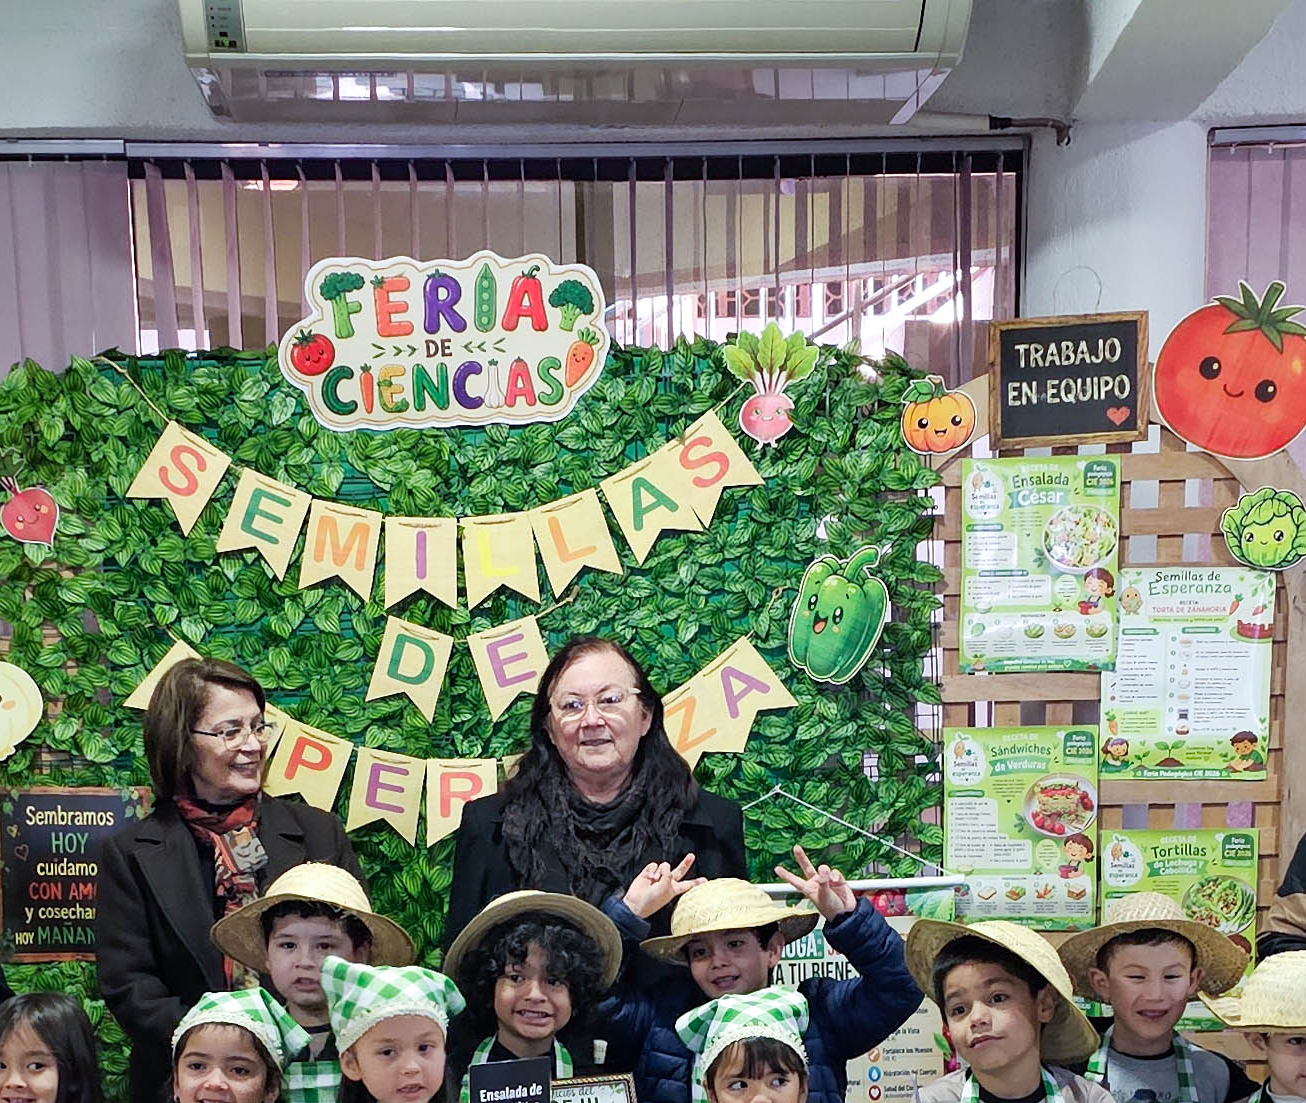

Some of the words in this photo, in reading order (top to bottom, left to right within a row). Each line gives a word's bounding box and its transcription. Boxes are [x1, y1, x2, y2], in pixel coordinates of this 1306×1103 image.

[319, 263, 549, 339] FERIA
[424, 338, 454, 358] DE
[1013, 336, 1122, 369] TRABAJO
[321, 356, 562, 414] CIENCIAS
[1007, 381, 1039, 407] EN
[1045, 373, 1131, 404] EQUIPO
[1012, 472, 1070, 489] Ensalada
[1017, 488, 1064, 506] César
[157, 435, 731, 580] SEMILLAS
[1155, 571, 1204, 583] Semillas
[1207, 571, 1221, 581] de
[1148, 581, 1232, 597] Esperanza
[389, 632, 537, 689] DE
[991, 743, 1052, 758] Sándwiches
[1006, 759, 1047, 771] Verduras
[25, 804, 114, 826] Sembramos
[51, 831, 89, 854] HOY
[1150, 843, 1207, 859] Tortillas
[36, 858, 98, 876] cuidamo
[29, 882, 62, 900] CON
[69, 882, 98, 900] AM
[24, 906, 34, 924] y
[15, 932, 35, 945] HOY
[38, 922, 96, 945] MAÑAN
[811, 961, 857, 981] BIENE
[479, 1085, 527, 1103] Ensalada
[529, 1082, 543, 1097] de
